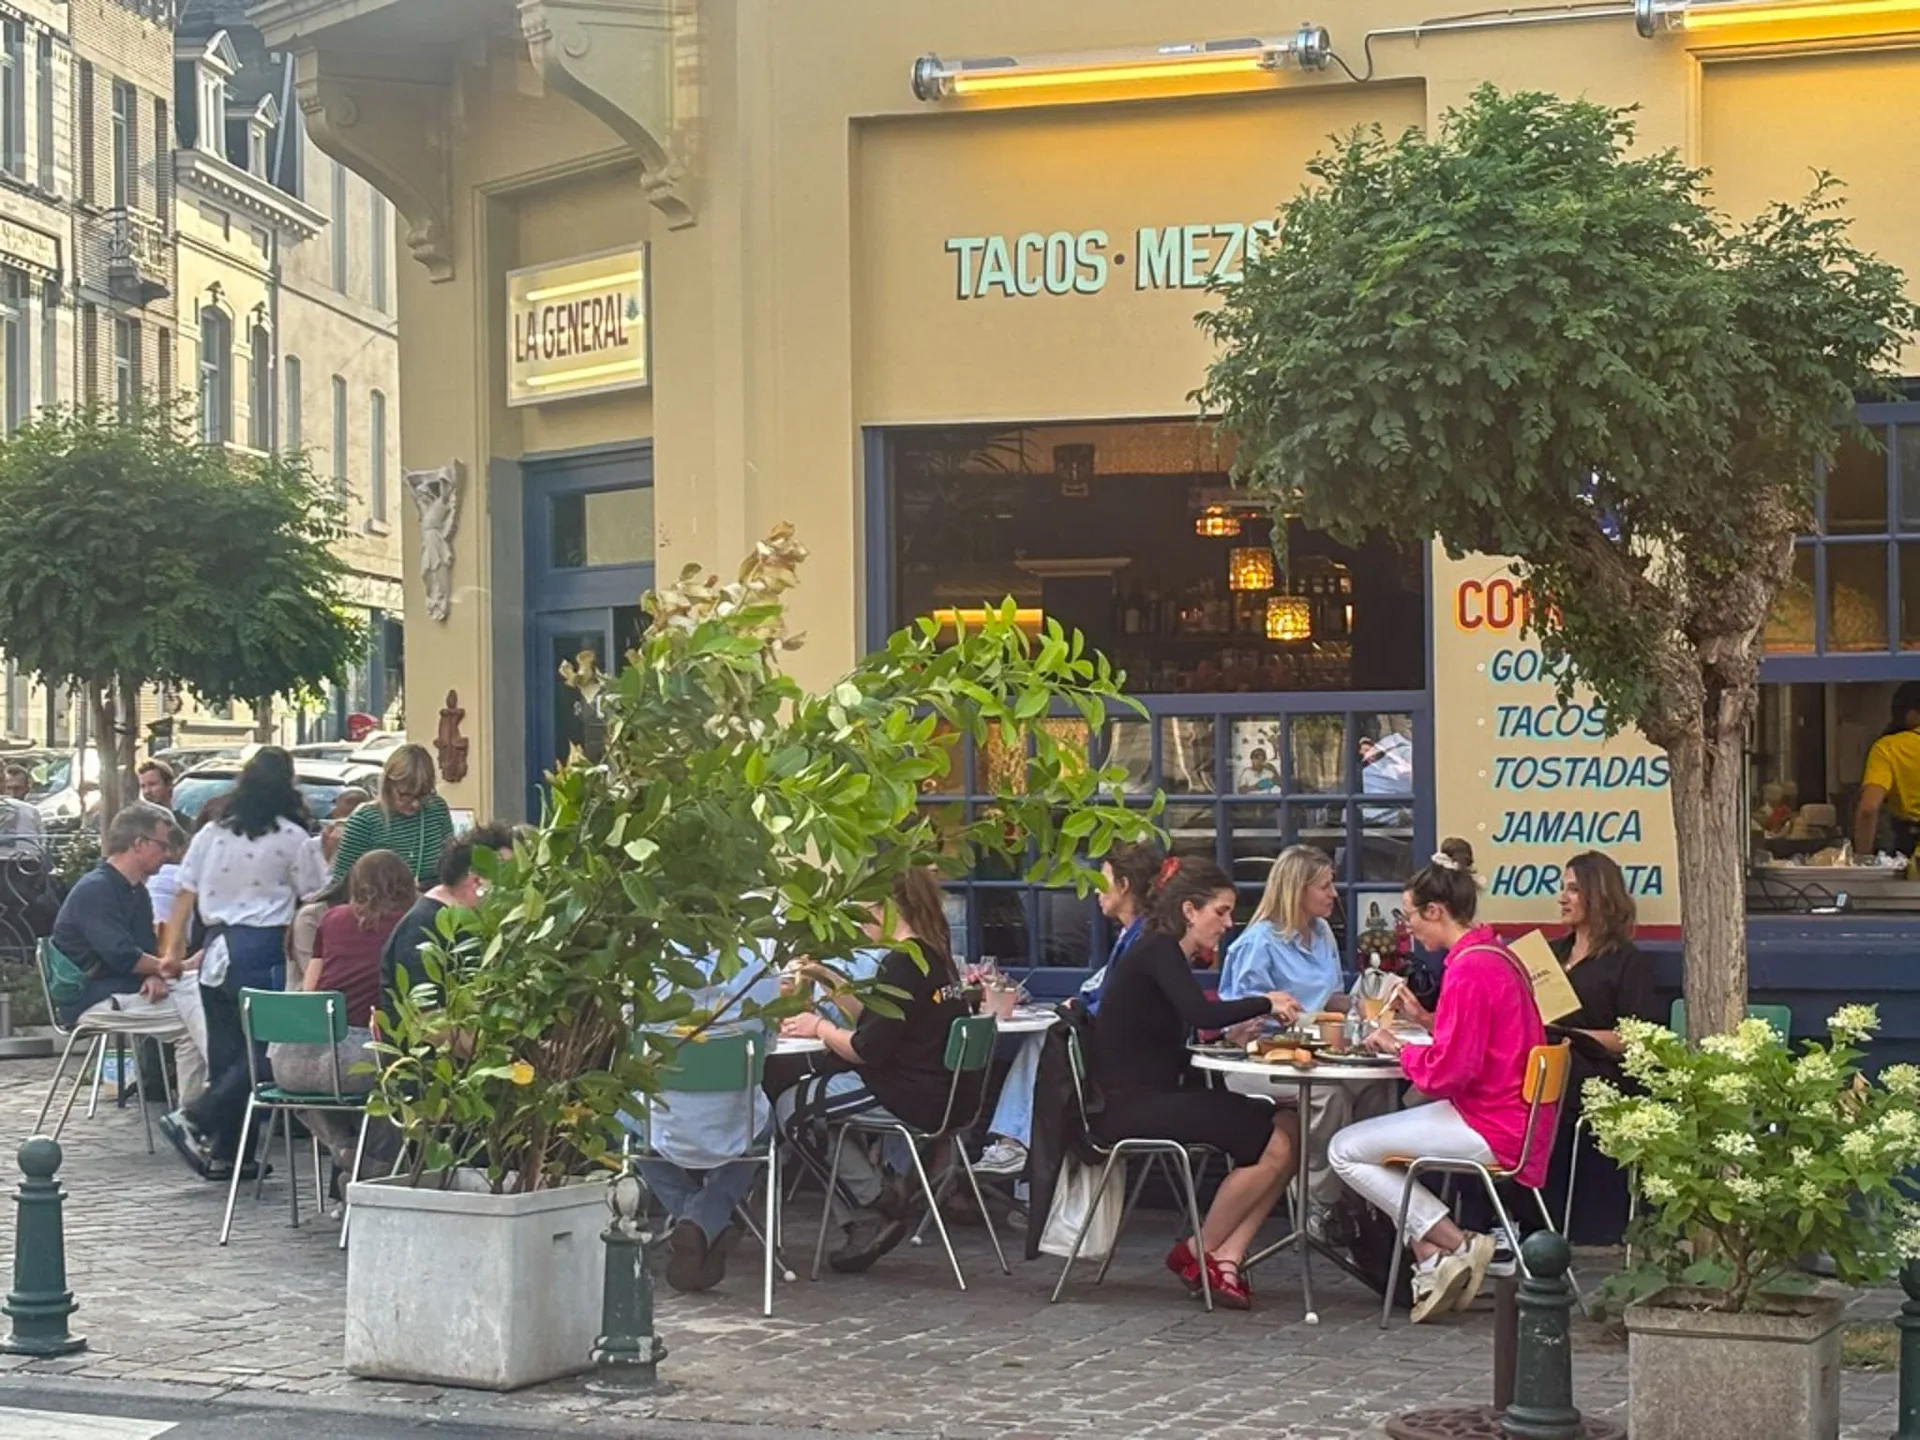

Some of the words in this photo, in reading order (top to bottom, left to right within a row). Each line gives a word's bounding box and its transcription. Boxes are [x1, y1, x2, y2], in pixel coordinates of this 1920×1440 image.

[945, 229, 1108, 300] TACOS
[515, 311, 538, 363] LA
[543, 292, 629, 360] GENERAL
[1497, 705, 1608, 738] TACOS
[1493, 756, 1671, 789] TOSTADAS
[1491, 810, 1642, 843] JAMAICA
[1491, 864, 1663, 896] HORTA
